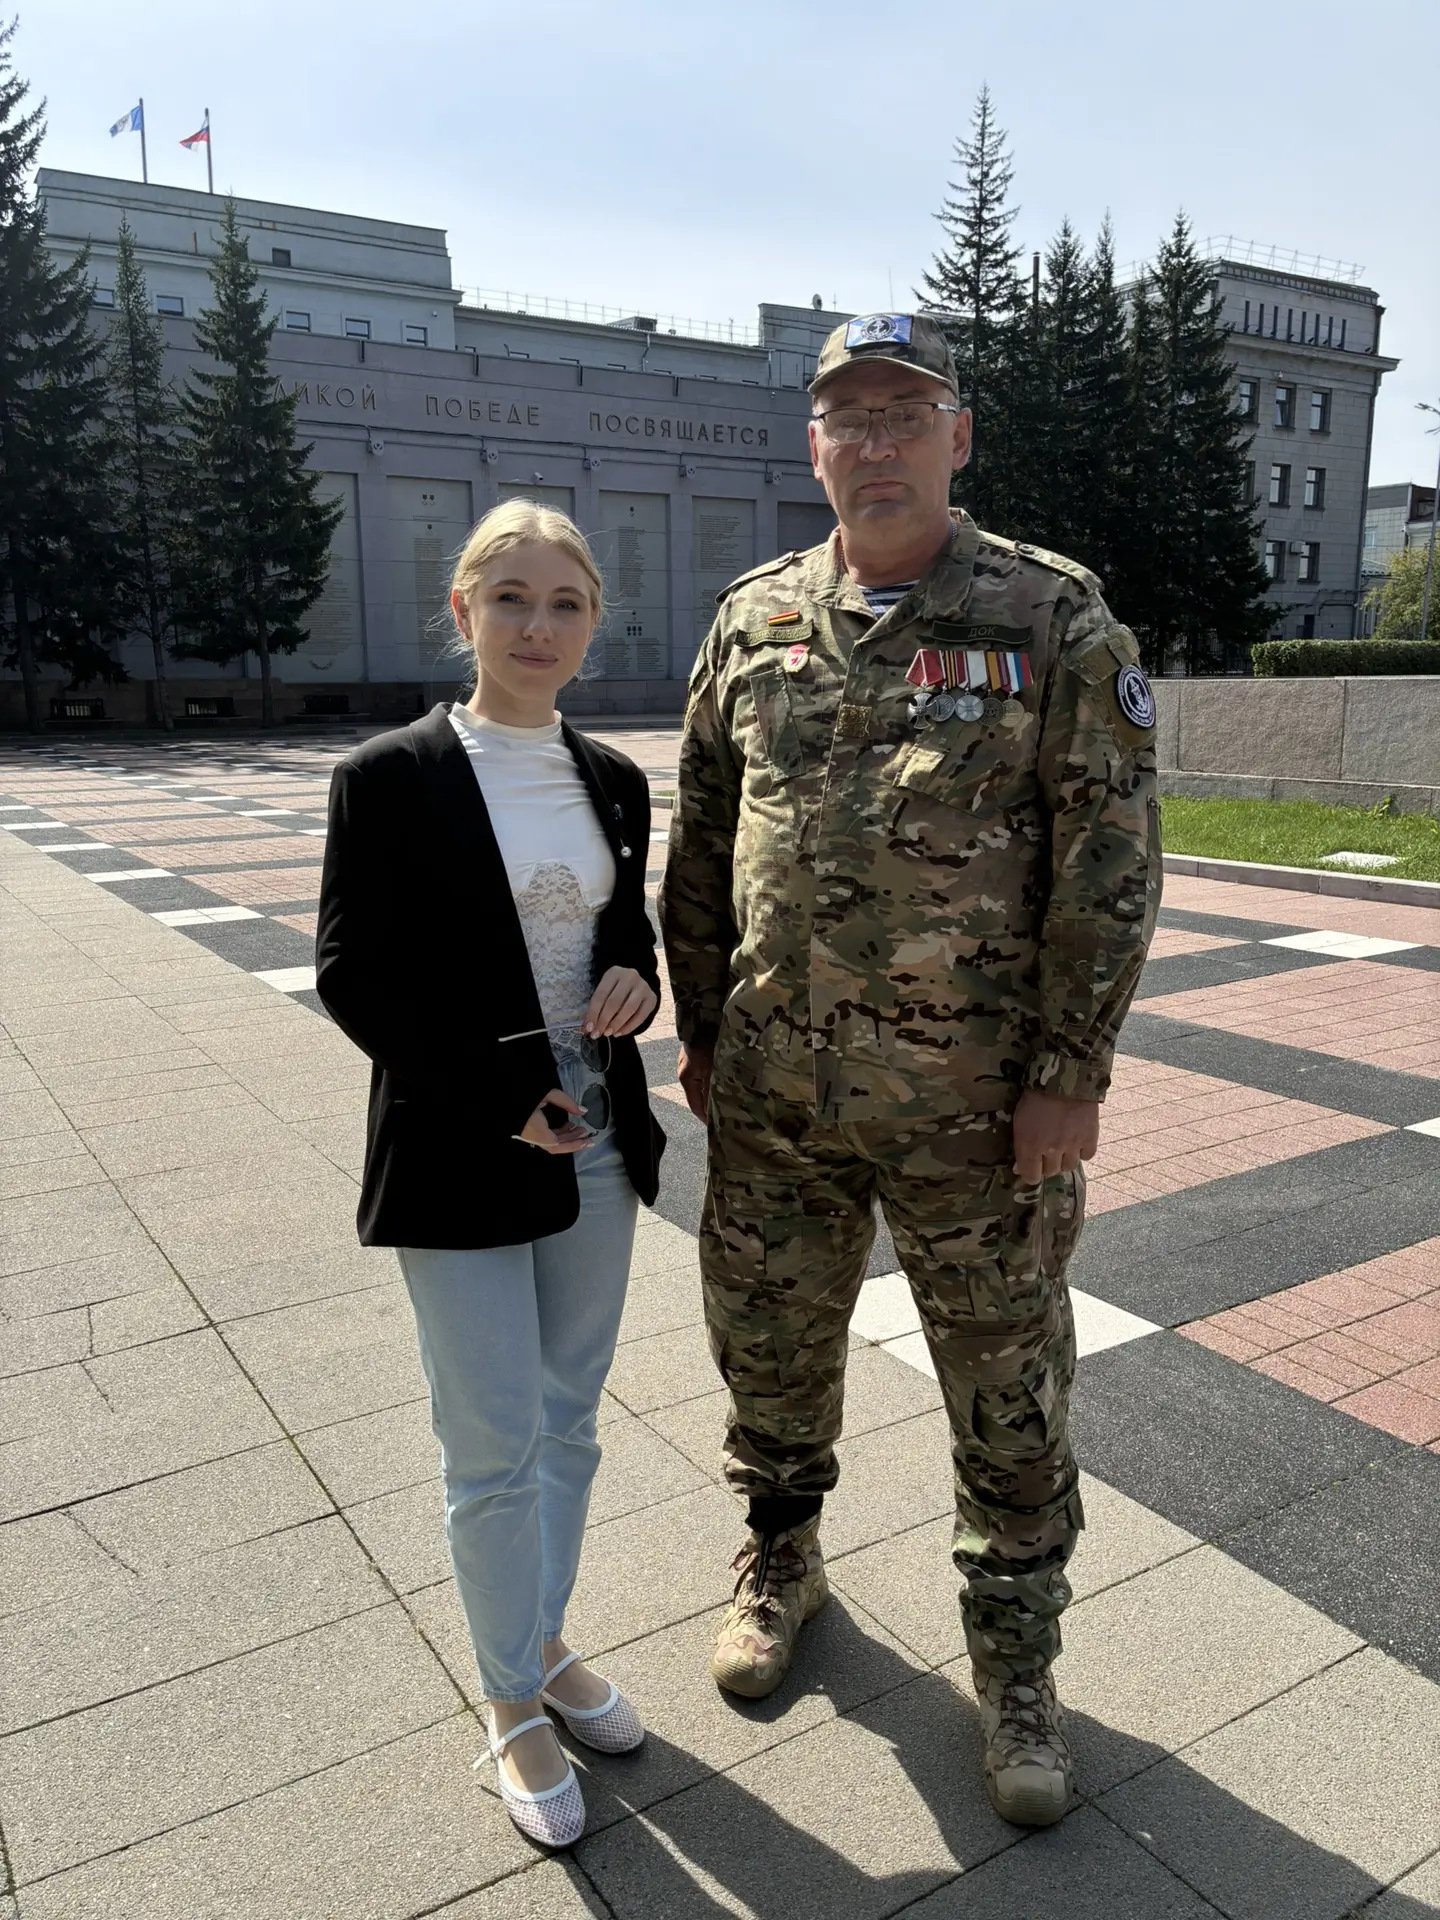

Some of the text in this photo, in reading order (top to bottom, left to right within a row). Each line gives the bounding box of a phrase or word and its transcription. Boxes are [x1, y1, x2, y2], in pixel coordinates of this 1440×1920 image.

[273, 379, 769, 447] ЛИКОЙ ПОБЕДЕ ПОСВЯЩАЕТСЯ
[967, 625, 997, 639] ДОК
